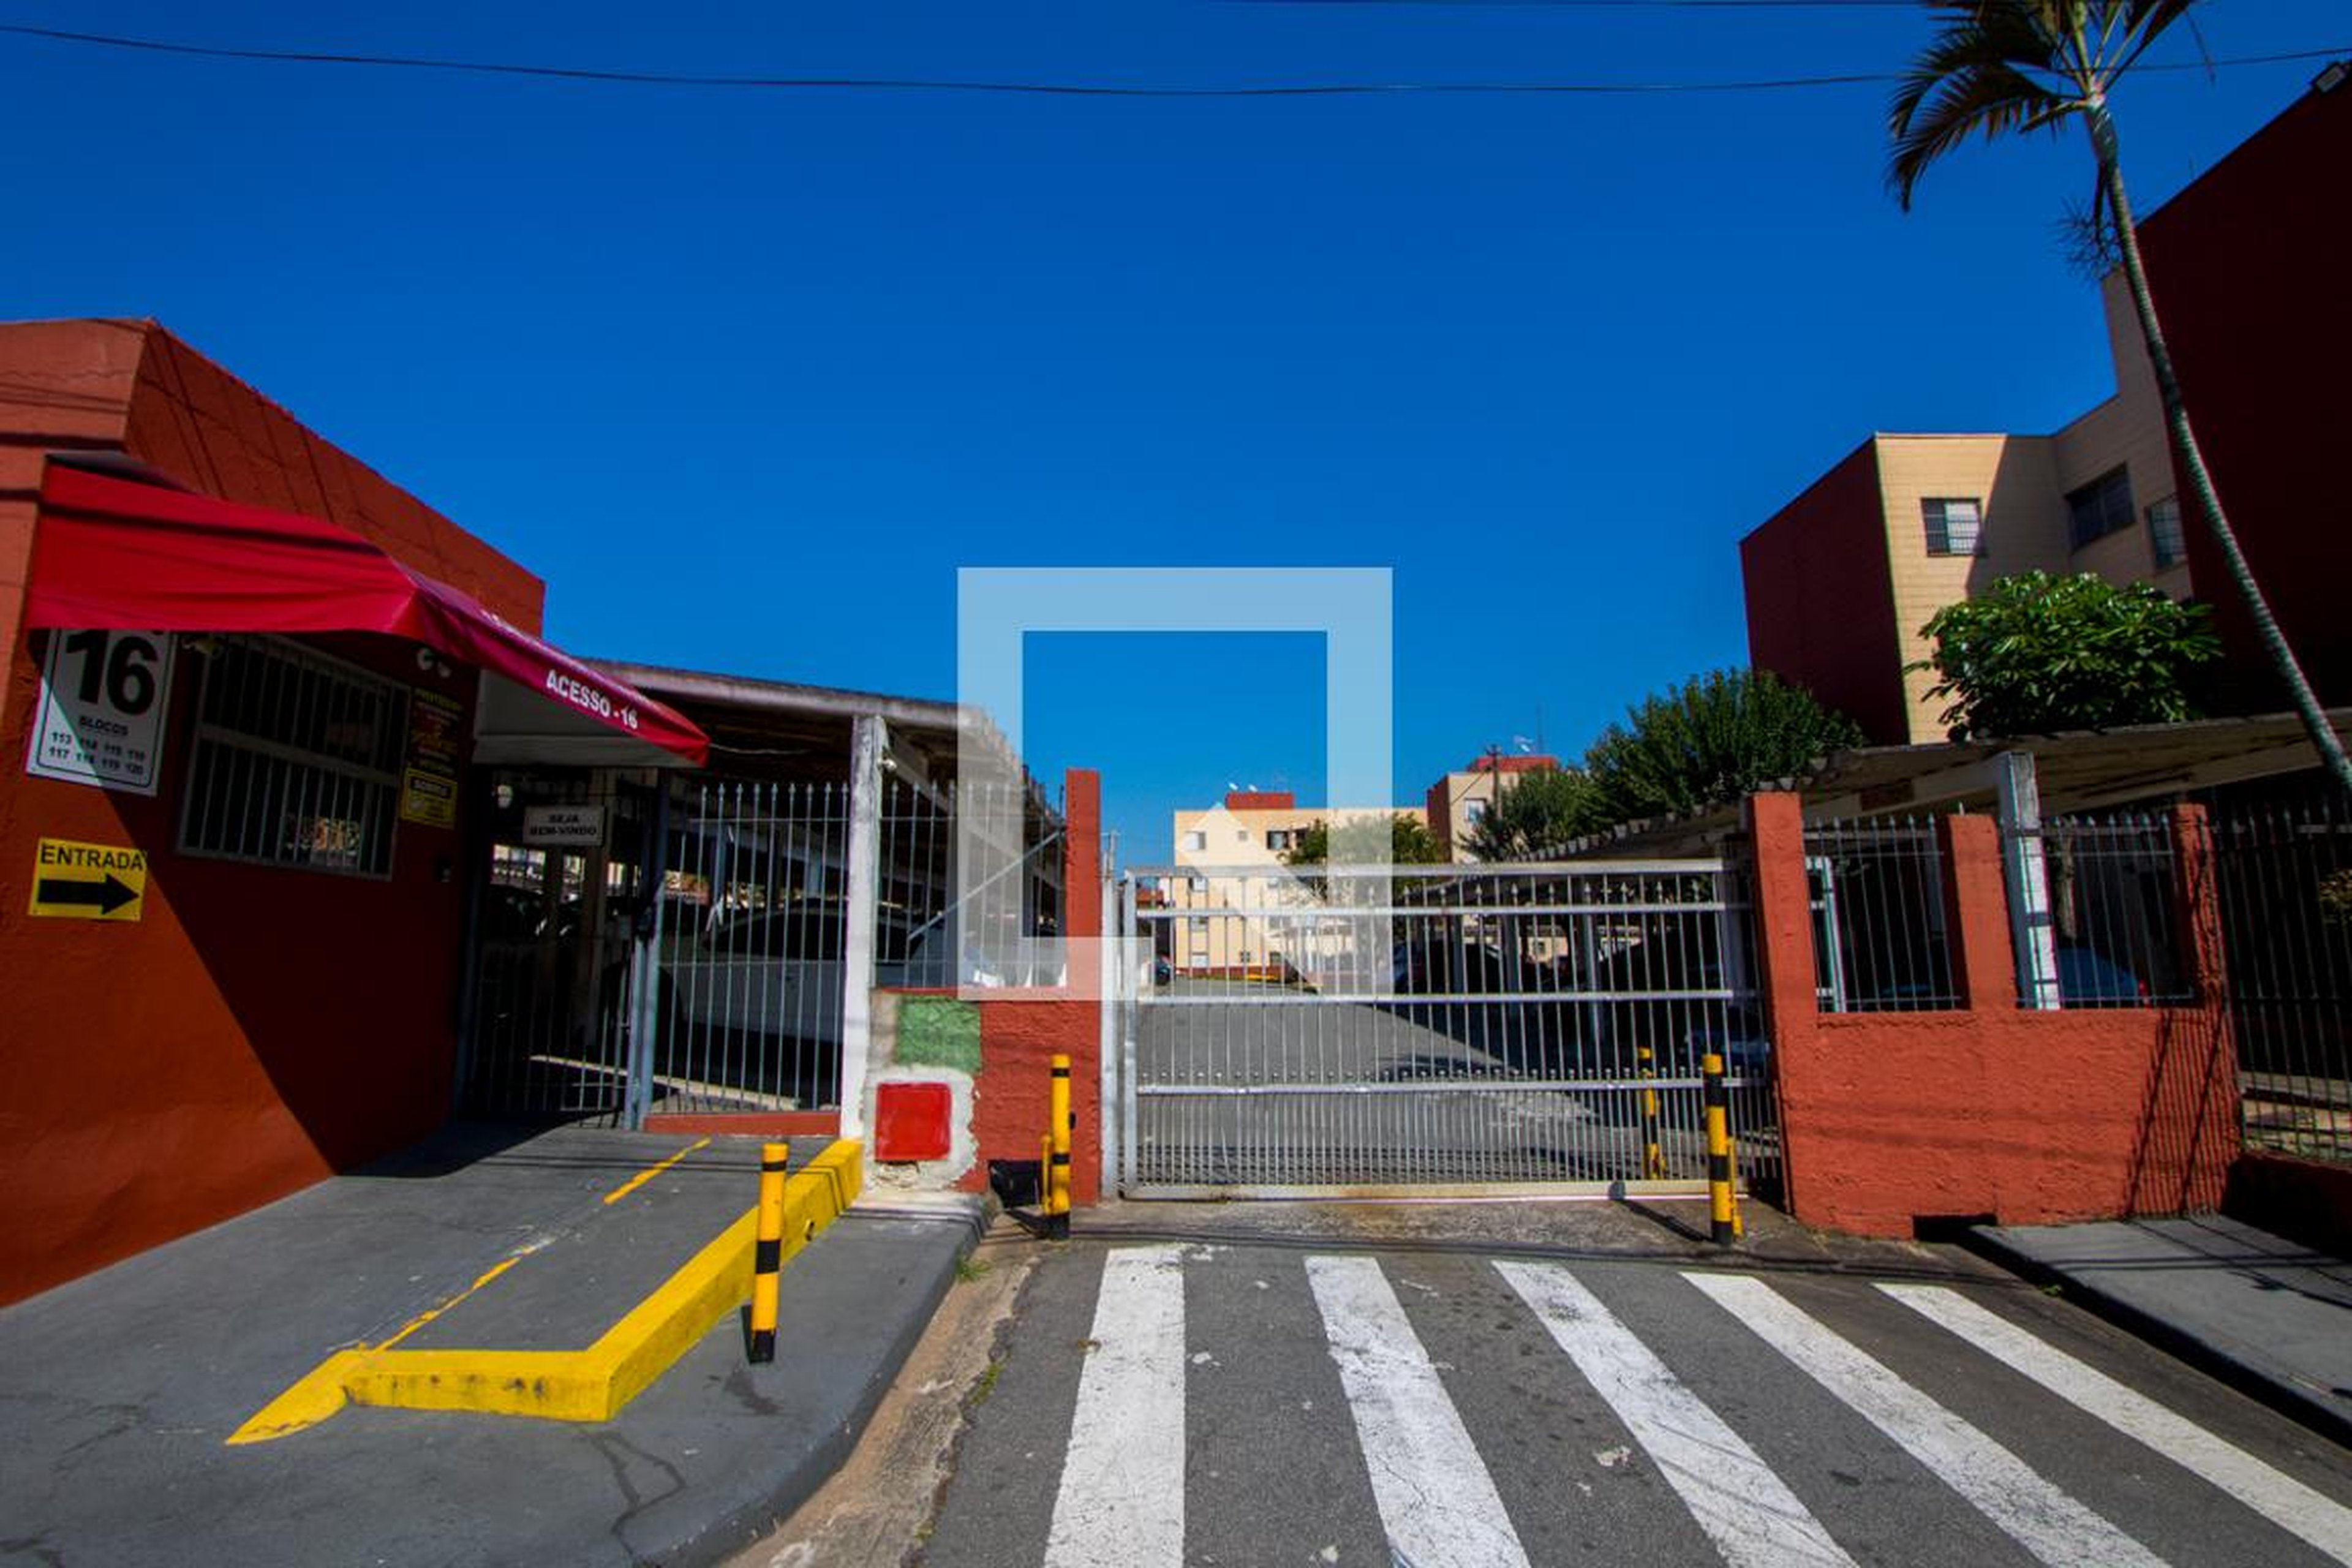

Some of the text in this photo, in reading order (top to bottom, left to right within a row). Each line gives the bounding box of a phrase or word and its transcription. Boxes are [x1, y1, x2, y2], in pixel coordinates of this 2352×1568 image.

[66, 630, 159, 715] 16
[546, 669, 611, 717] ACESSO
[80, 716, 128, 735] BLOCOS
[50, 747, 69, 759] 117
[40, 843, 143, 871] ENTRADA
